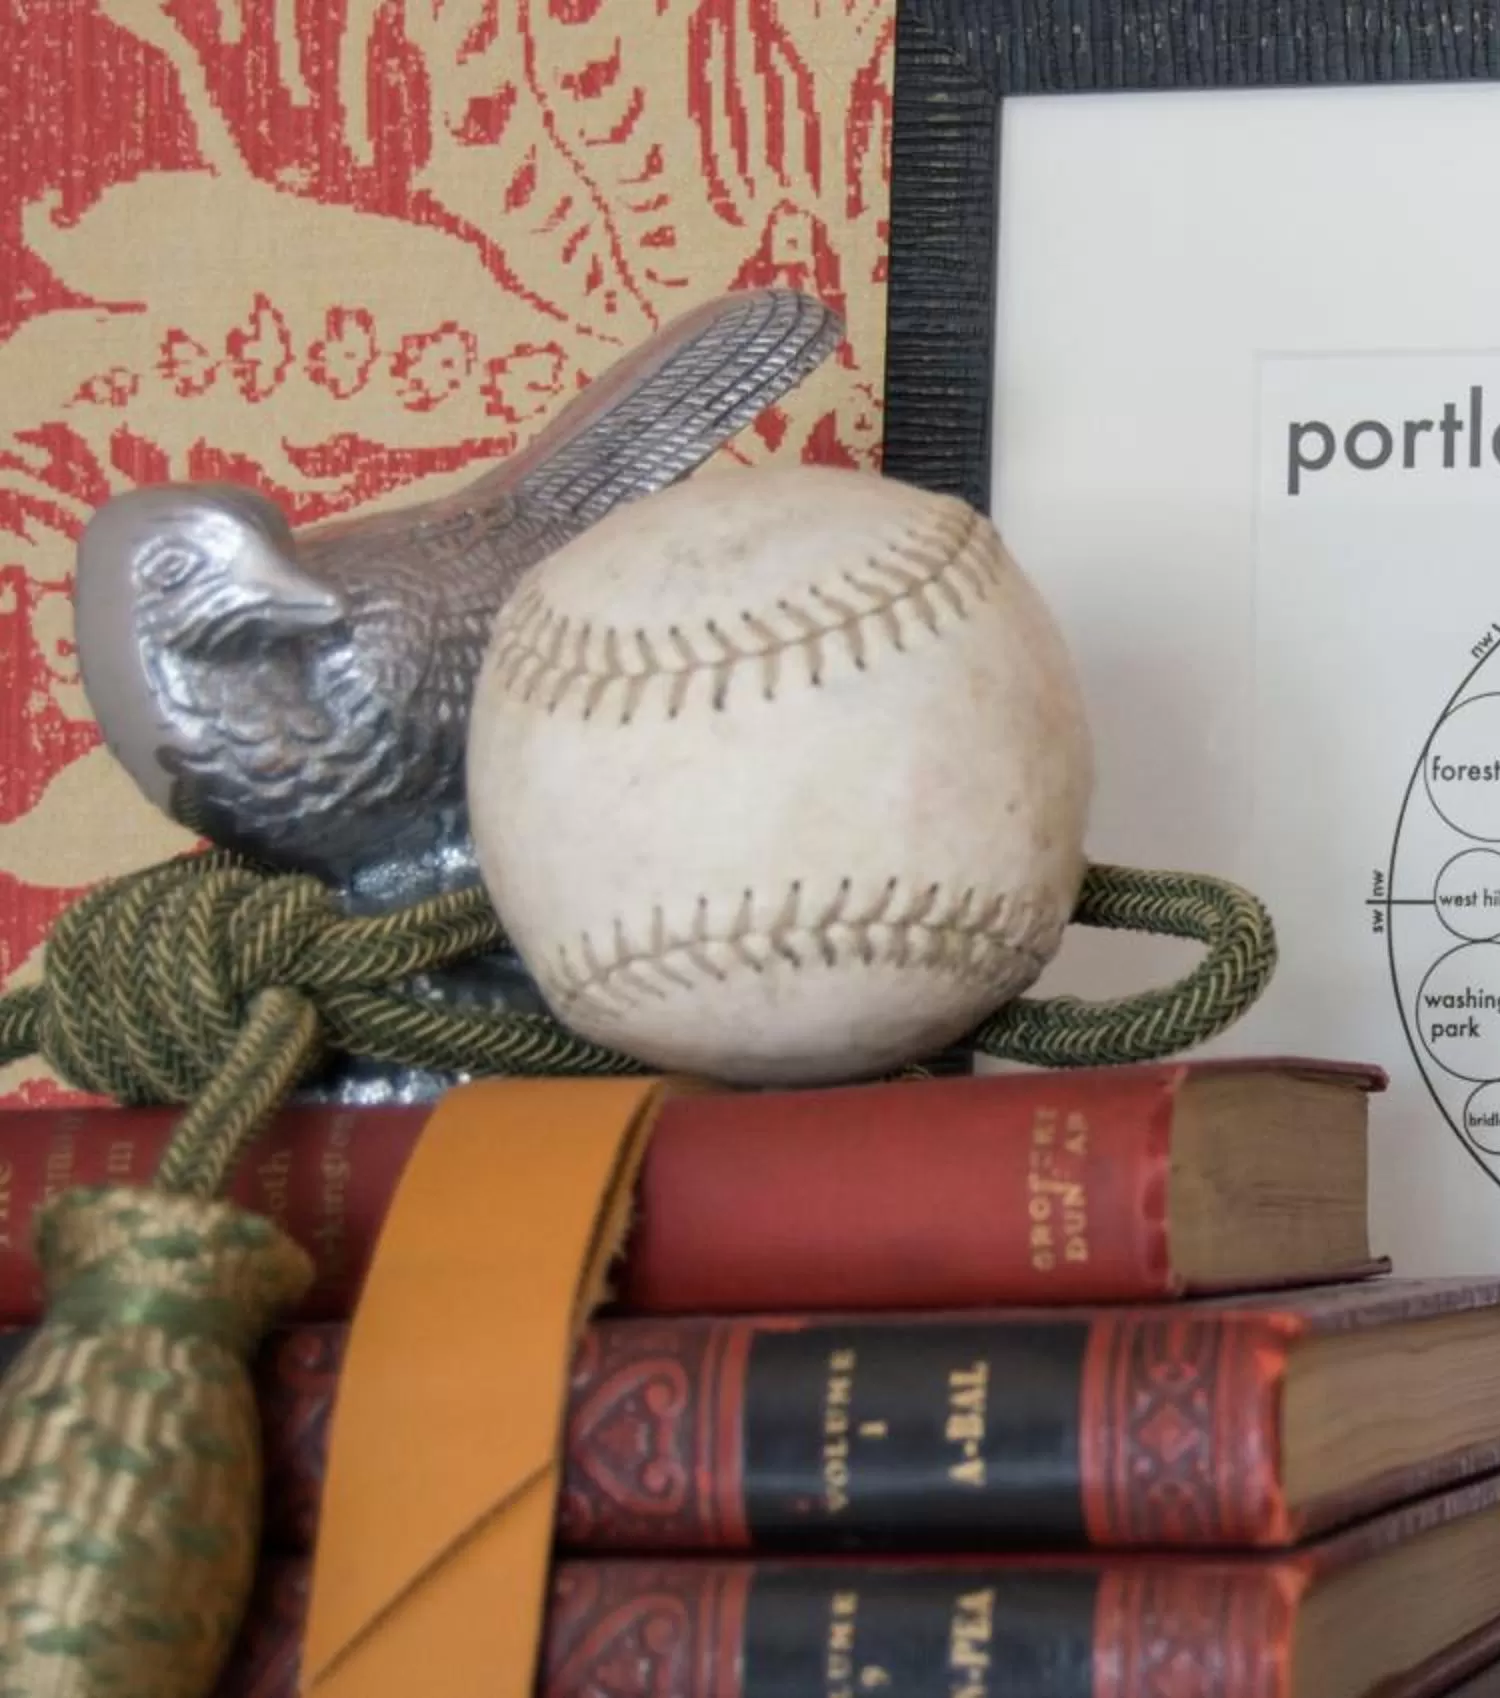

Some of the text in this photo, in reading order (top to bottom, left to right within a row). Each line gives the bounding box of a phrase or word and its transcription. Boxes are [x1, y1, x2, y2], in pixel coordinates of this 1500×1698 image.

[1470, 631, 1495, 659] nw
[1433, 757, 1500, 780] forest
[1373, 871, 1384, 897] nw
[1439, 893, 1478, 907] west
[1372, 909, 1383, 933] sw
[1432, 1019, 1480, 1042] park
[1065, 1112, 1089, 1264] DUNAP
[825, 1348, 856, 1512] VOLUME
[947, 1361, 989, 1487] A-BAL
[827, 1590, 857, 1698] LUME
[860, 1665, 890, 1687] 9
